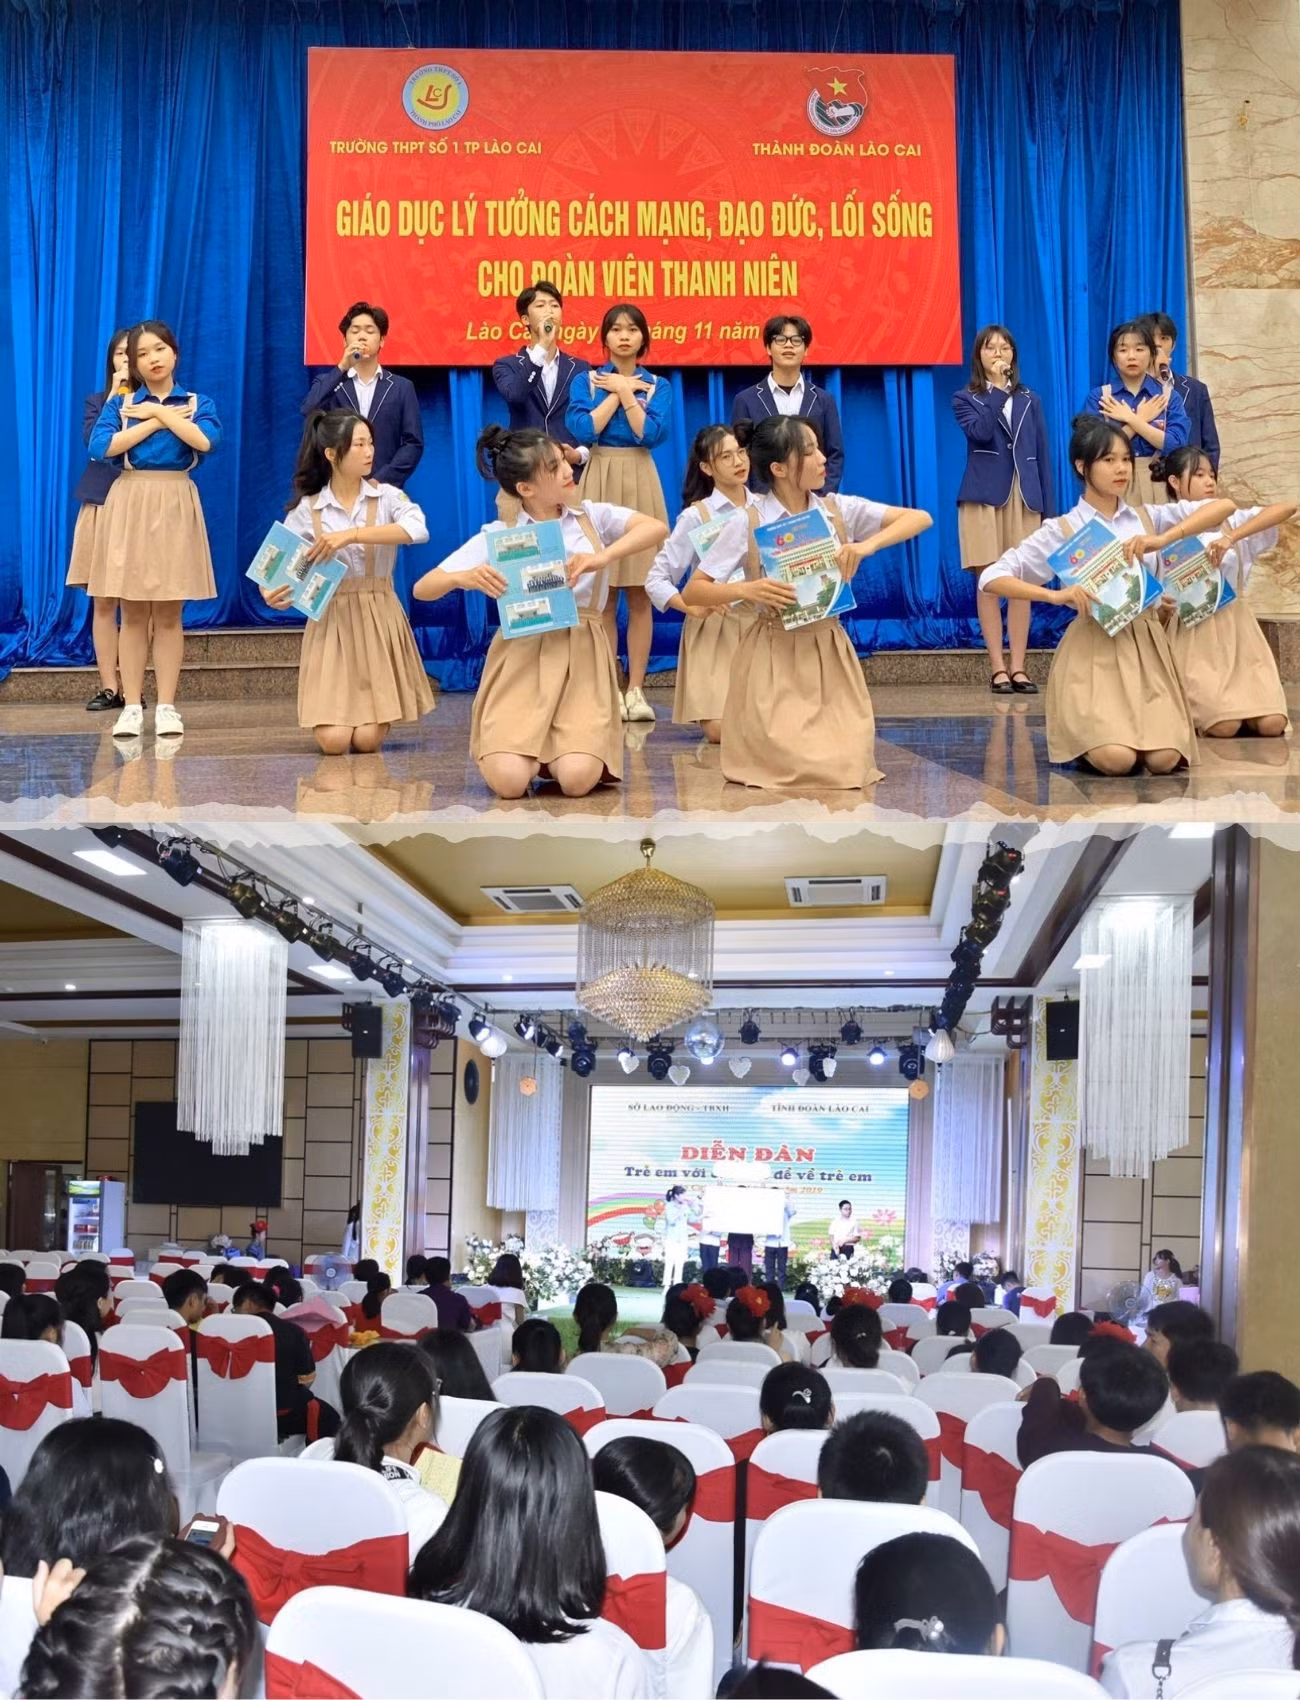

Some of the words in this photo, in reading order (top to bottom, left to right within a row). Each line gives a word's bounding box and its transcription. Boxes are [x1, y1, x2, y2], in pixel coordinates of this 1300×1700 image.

[330, 137, 388, 154] TRƯỜNG
[392, 141, 425, 154] THPT
[428, 136, 448, 154] SỐ
[452, 141, 459, 154] 1
[464, 141, 480, 154] TP
[484, 138, 512, 155] LÀO
[516, 142, 542, 155] CAI
[752, 139, 804, 156] THÀNH
[809, 140, 854, 156] ĐOÀN
[859, 140, 890, 156] LÀO
[893, 144, 921, 156] CAI
[336, 192, 391, 237] GIÁO
[398, 200, 444, 245] DỤC
[452, 192, 478, 237] LÝ
[485, 188, 561, 237] TƯỞNG
[568, 192, 629, 237] CÁCH
[637, 200, 712, 245] MẠNG,
[719, 200, 765, 245] ĐẠO
[771, 193, 824, 241] ĐỨC,
[831, 188, 865, 237] LỐI
[871, 189, 933, 238] SỐNG
[478, 260, 524, 297] CHO
[531, 253, 594, 297] ĐOÀN
[602, 253, 654, 297] VIÊN
[661, 260, 736, 297] THANH
[744, 253, 798, 297] NIÊN
[466, 321, 502, 341] Lào
[508, 321, 533, 341] Ca
[648, 321, 688, 345] áng
[693, 321, 712, 340] 11
[719, 321, 761, 341] năm
[643, 1104, 664, 1112] LAO
[798, 1103, 827, 1113] ĐOÀN
[829, 1104, 849, 1113] LÀO
[851, 1105, 870, 1113] CAI
[681, 1140, 747, 1161] DIỄN
[755, 1144, 816, 1162] ĐÀN
[624, 1164, 651, 1178] Trẻ
[655, 1168, 678, 1178] em
[682, 1167, 706, 1179] với
[773, 1167, 792, 1180] đề
[797, 1167, 816, 1181] về
[849, 1172, 873, 1182] em
